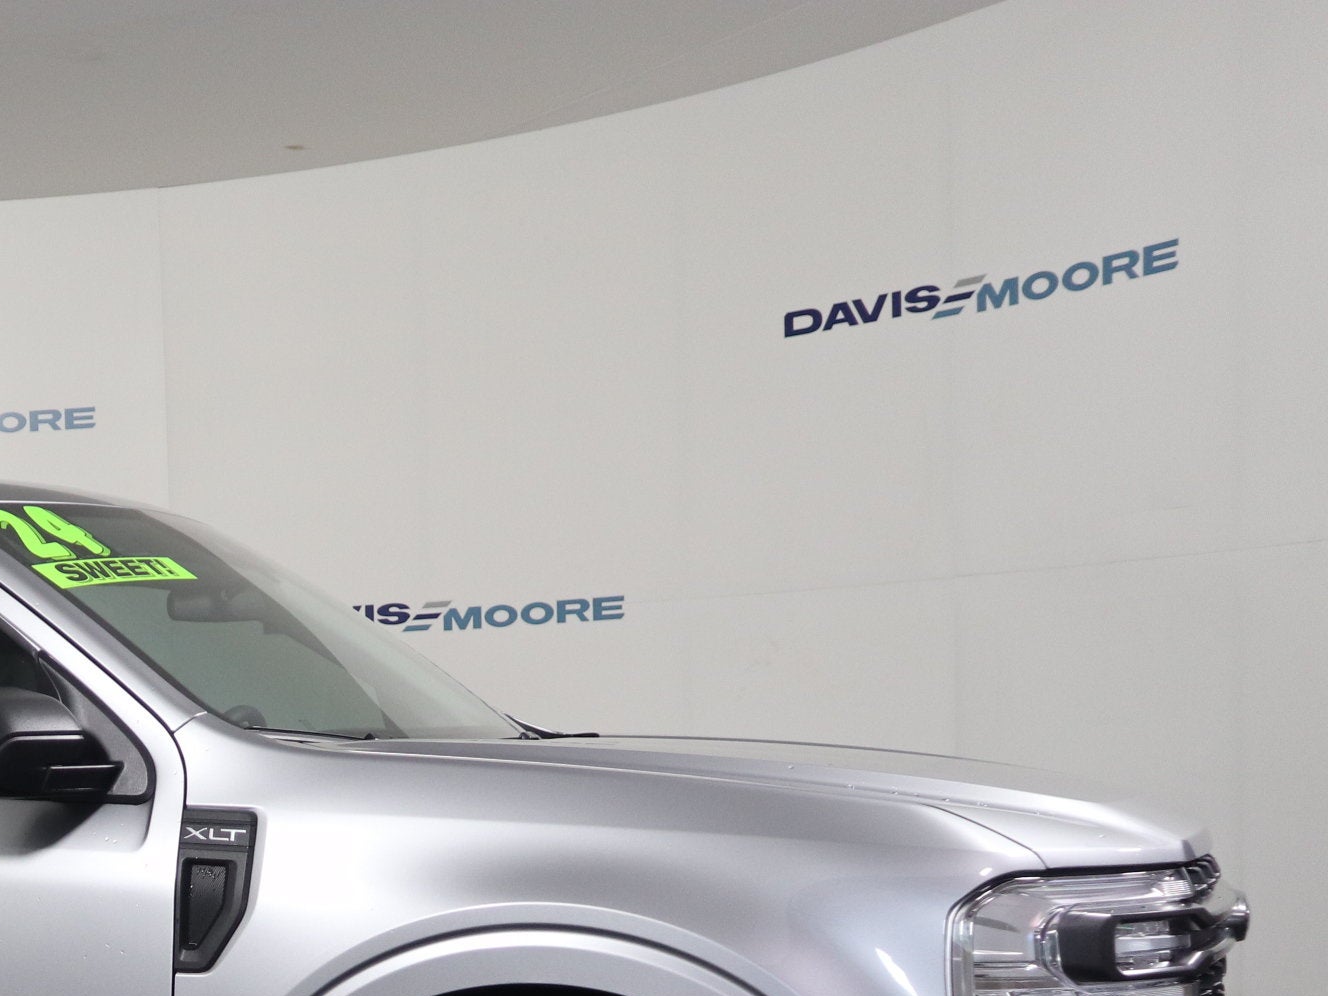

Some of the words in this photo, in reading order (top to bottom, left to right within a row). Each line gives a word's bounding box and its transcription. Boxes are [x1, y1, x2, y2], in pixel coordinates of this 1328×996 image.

[784, 284, 942, 338] DAVIS
[976, 238, 1180, 313] MOORE
[54, 558, 178, 583] SWEET!
[442, 595, 625, 631] MOORE
[183, 826, 247, 842] XLT
